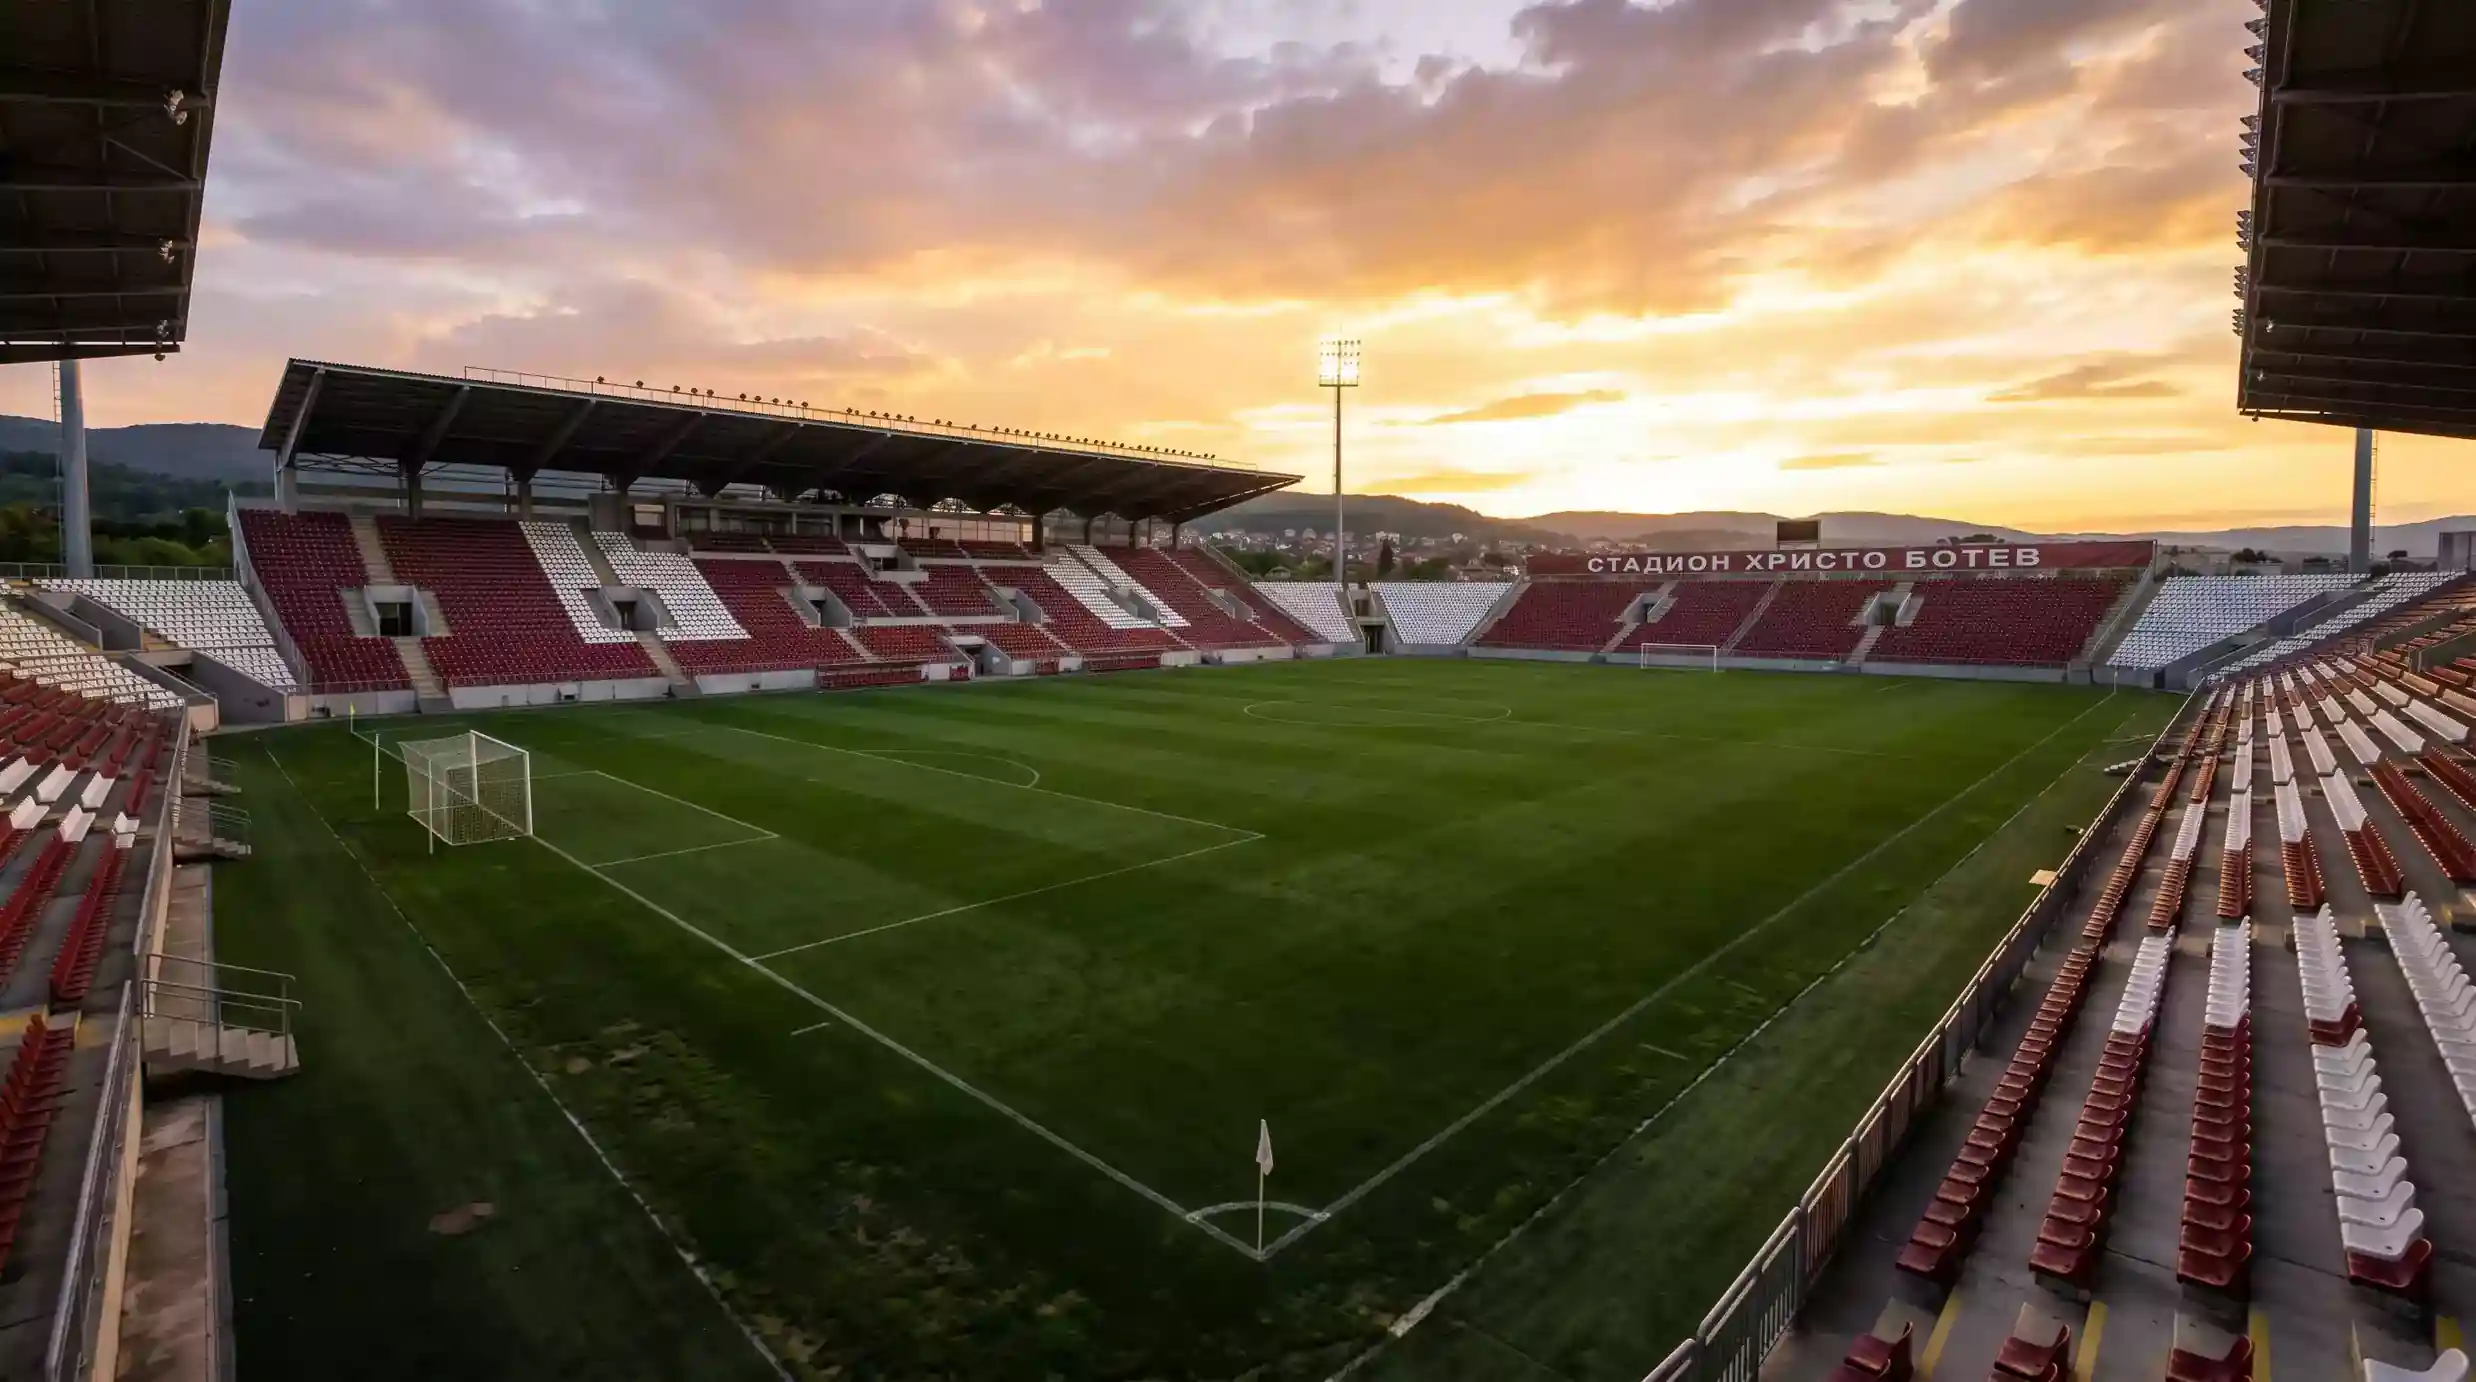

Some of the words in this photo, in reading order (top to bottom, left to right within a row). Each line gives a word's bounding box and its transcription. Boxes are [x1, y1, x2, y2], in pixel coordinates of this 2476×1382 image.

[1587, 555, 1730, 575] СТАДИОН
[1745, 551, 1887, 571] ХРИСТО
[1905, 548, 2041, 569] БОТЕВ
